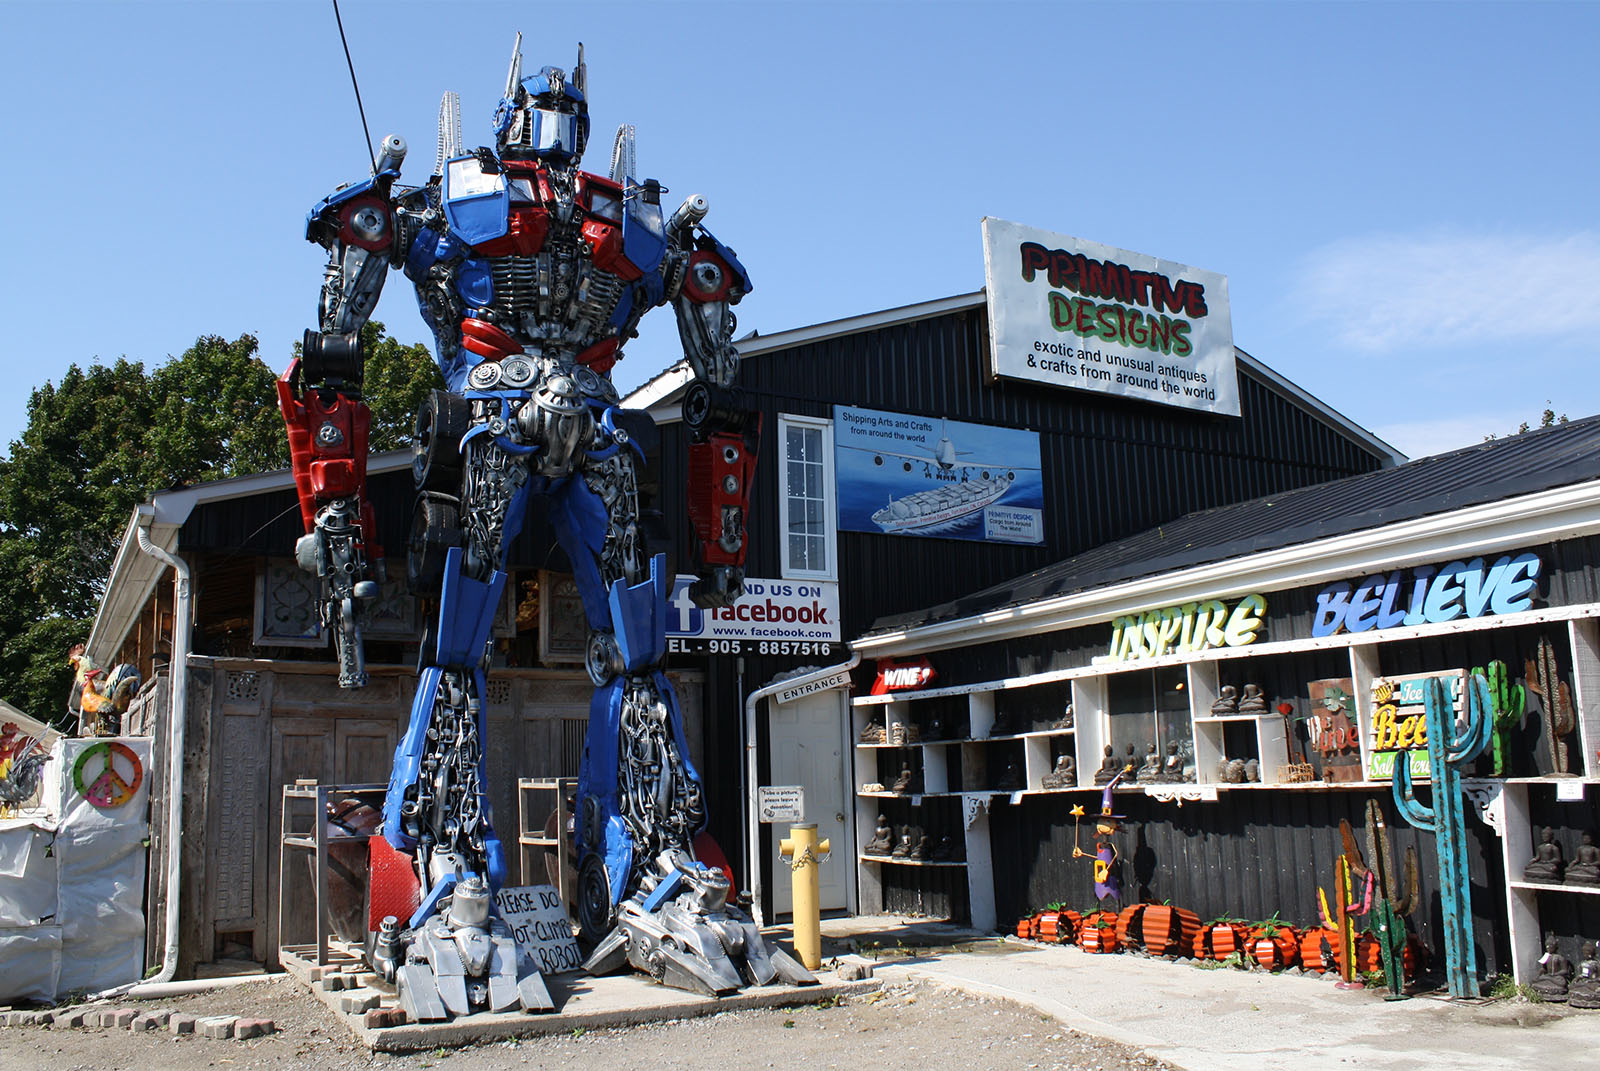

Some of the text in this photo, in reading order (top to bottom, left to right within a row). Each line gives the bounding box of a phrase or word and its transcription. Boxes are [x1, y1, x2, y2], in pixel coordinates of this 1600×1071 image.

[1021, 242, 1207, 318] PRIMITIVE
[1050, 292, 1192, 356] DESIGNS
[1034, 340, 1207, 384] exotic and unusual antiques
[1027, 353, 1215, 400] & crafts from around the world
[842, 412, 933, 432] Shipping Arts and Crafts
[851, 426, 925, 443] from around the world
[744, 584, 765, 596] ND
[771, 584, 793, 597] US
[798, 586, 822, 598] ON
[1313, 553, 1541, 638] BELIEVE
[713, 626, 832, 639] www. facebook.com
[1109, 594, 1267, 661] INSPIRE
[667, 639, 691, 653] EL
[709, 640, 741, 654] 905
[759, 642, 831, 656] 8857516
[884, 666, 921, 686] WINE
[783, 675, 844, 700] ENTRANCE
[1401, 683, 1423, 702] Ice
[1373, 704, 1429, 751] Bee
[1372, 755, 1395, 776] Sol
[539, 891, 559, 910] DO
[535, 919, 574, 941] CLIMB
[539, 943, 581, 972] ROBOT
